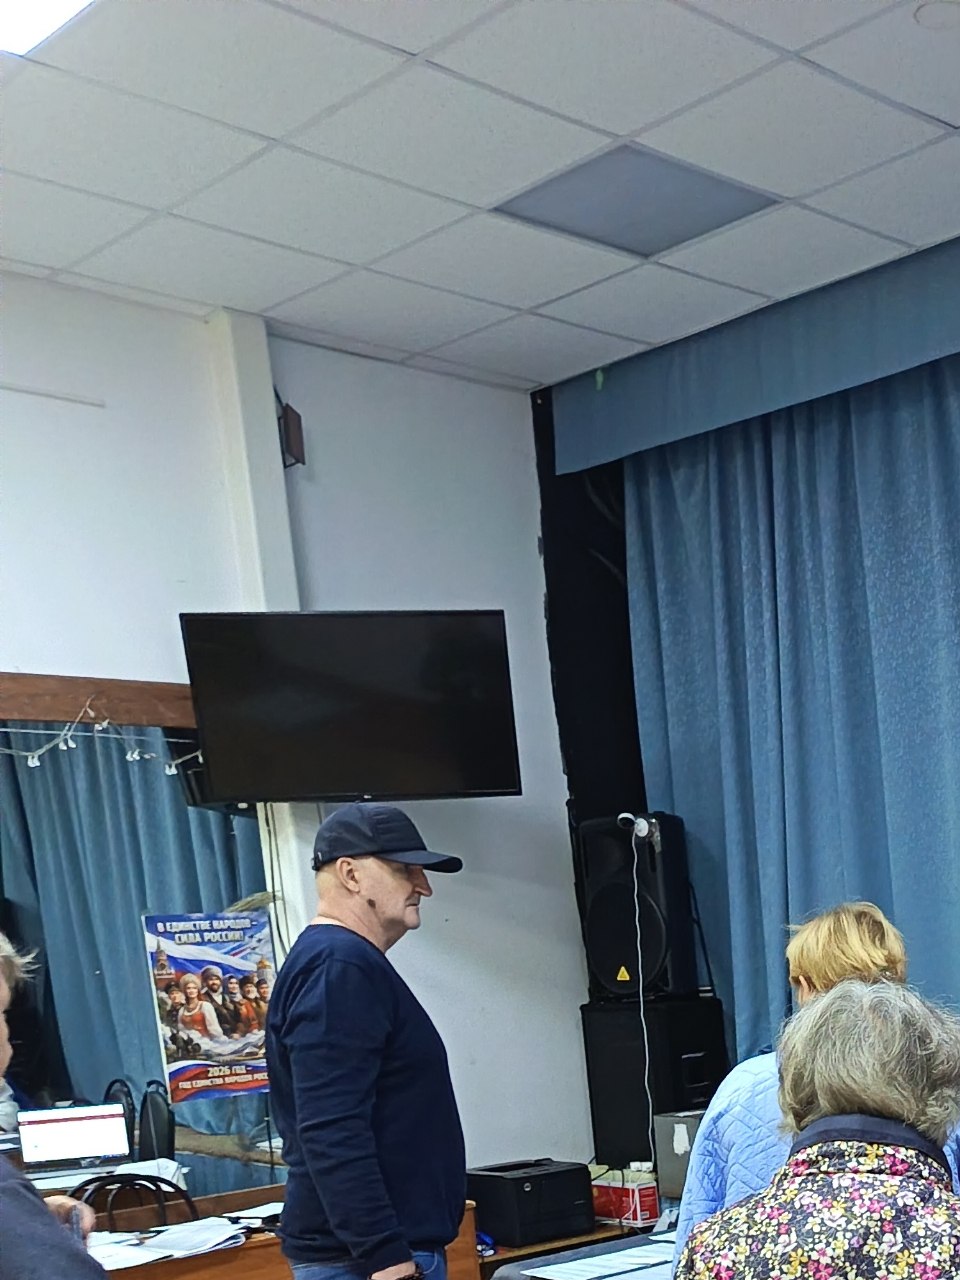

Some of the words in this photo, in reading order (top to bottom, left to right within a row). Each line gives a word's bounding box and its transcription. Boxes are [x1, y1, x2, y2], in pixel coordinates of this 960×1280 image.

[157, 922, 165, 932] В
[166, 921, 211, 932] ЕДИНСТВЕ
[175, 933, 202, 944] СИЛА
[203, 931, 244, 942] РОССИИ!
[208, 1066, 230, 1076] 2026
